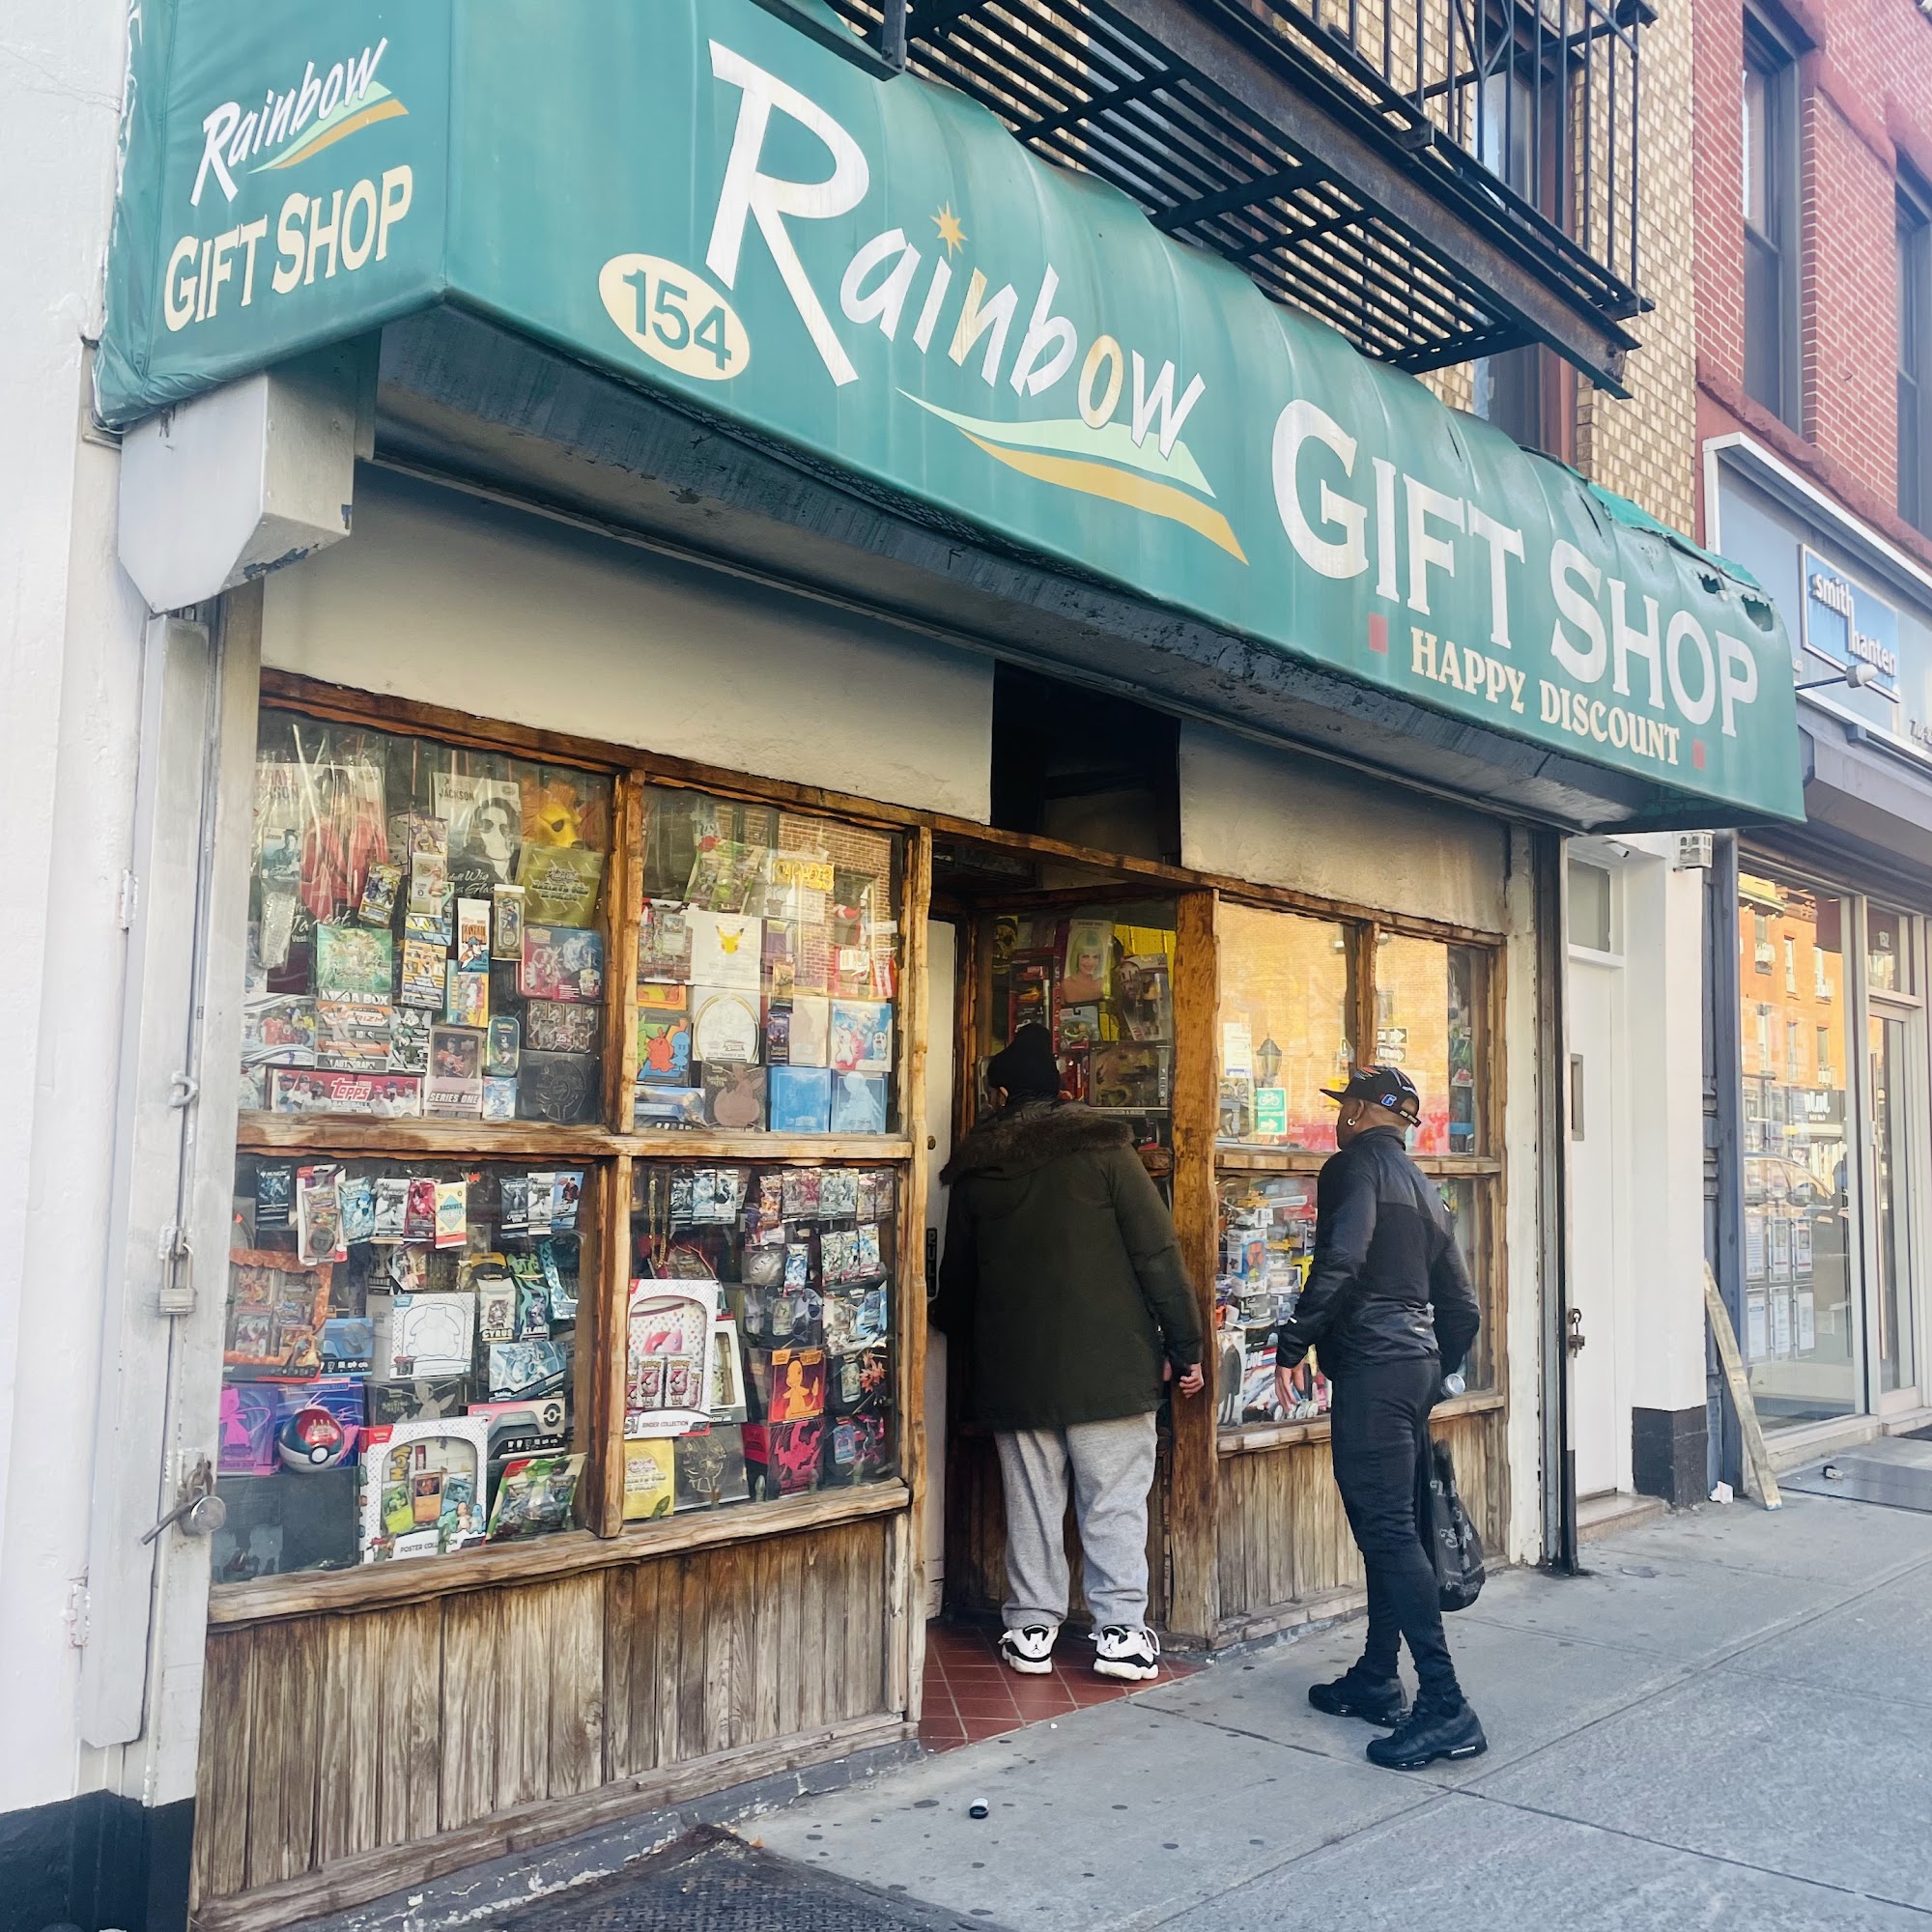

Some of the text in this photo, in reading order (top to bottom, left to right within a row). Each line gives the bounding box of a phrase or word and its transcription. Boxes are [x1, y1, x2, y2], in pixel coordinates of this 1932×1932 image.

[190, 37, 387, 207] Rainbow
[163, 164, 412, 331] GIFT SHOP
[705, 39, 1206, 461] Rainbow
[621, 268, 732, 371] 154
[1272, 399, 1759, 737] GIFT SHOP
[1810, 574, 1855, 618] smith
[1410, 626, 1681, 766] HAPPY DISCOUNT
[440, 788, 474, 802] JACKSON
[465, 868, 490, 883] Wig
[465, 881, 494, 895] Glas
[322, 989, 389, 1007] MEGA BOX
[429, 1093, 480, 1105] SERIES ONE
[482, 1329, 513, 1339] CYRUS
[400, 1544, 422, 1553] POSTER
